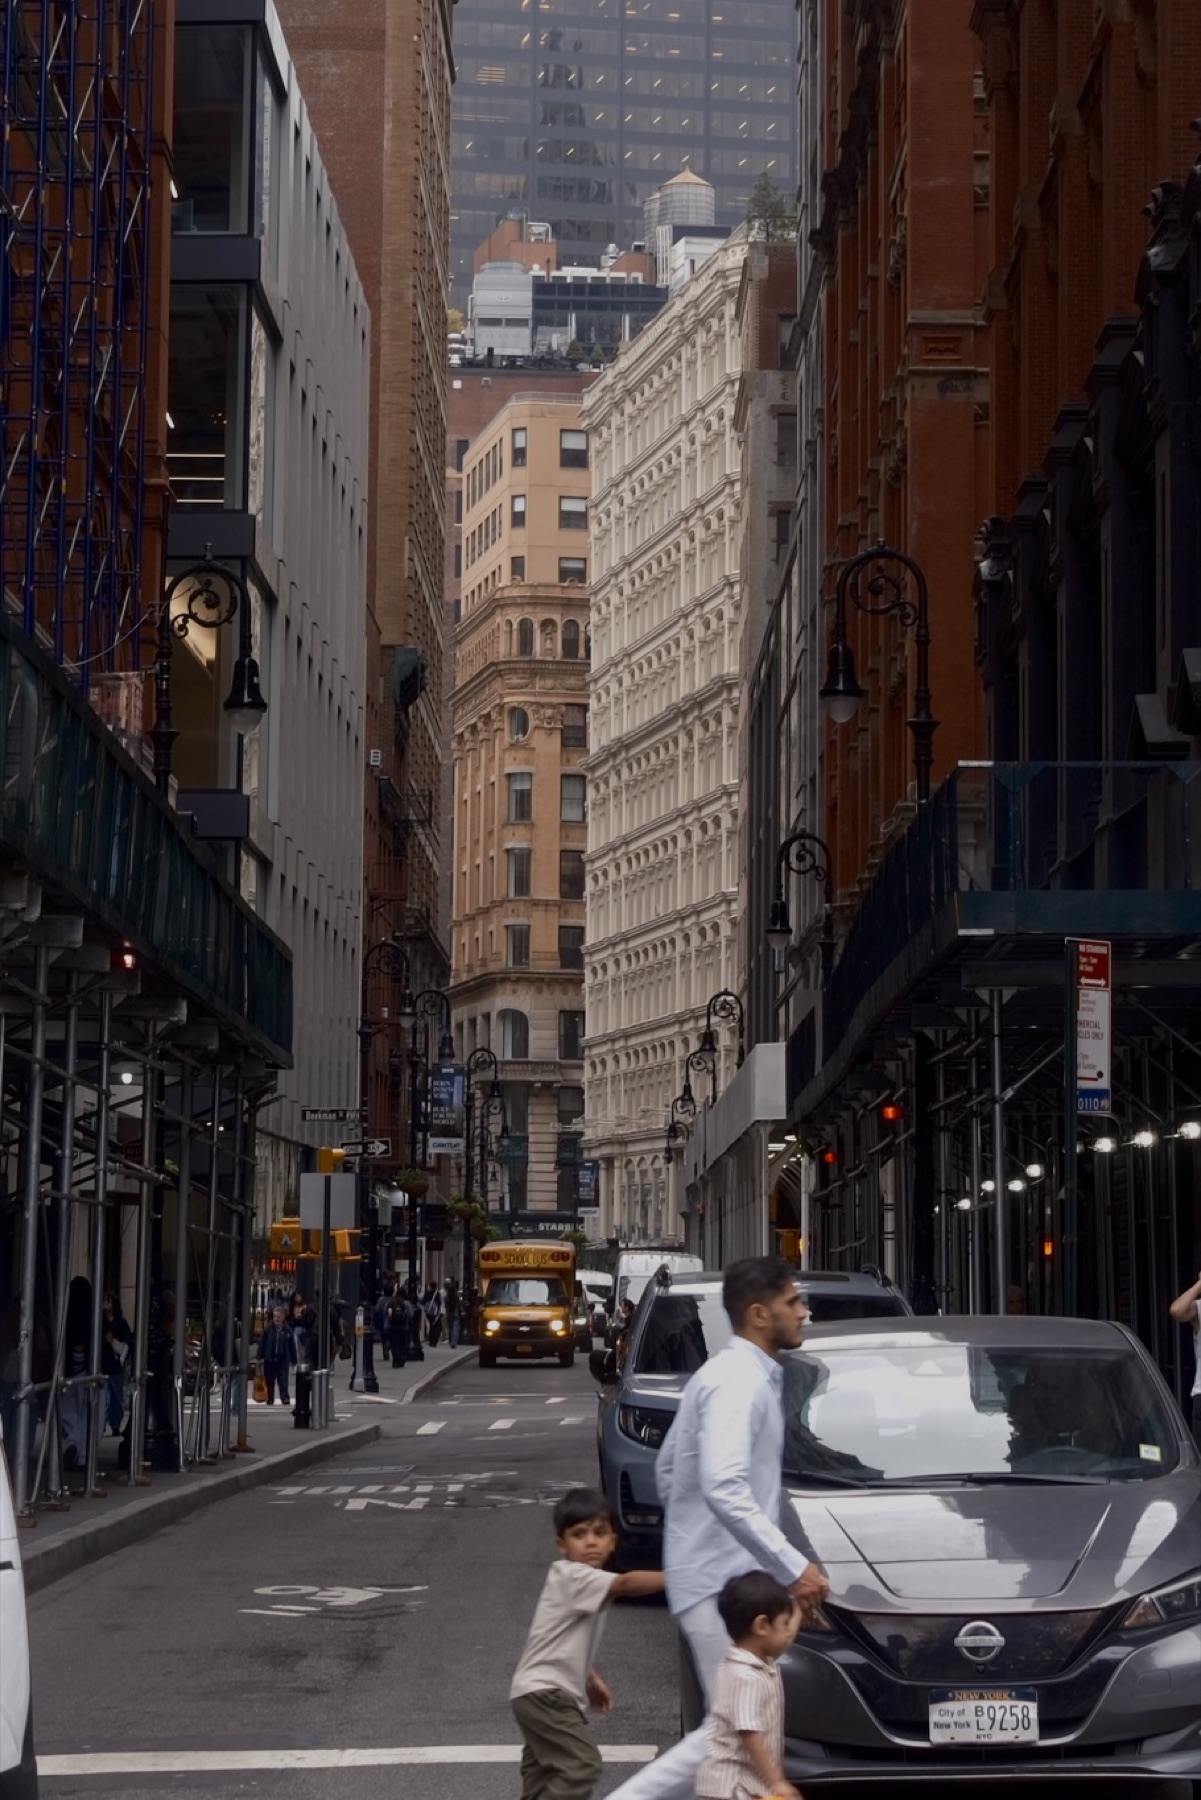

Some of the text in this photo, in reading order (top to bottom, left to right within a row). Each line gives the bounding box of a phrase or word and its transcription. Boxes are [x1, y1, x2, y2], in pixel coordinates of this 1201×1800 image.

[1086, 945, 1107, 954] STANDING
[1091, 1031, 1104, 1040] ONLY
[1078, 1097, 1099, 1110] 0110
[305, 1110, 337, 1120] Beekman
[504, 1253, 547, 1264] SCHOOL BUS
[954, 1691, 1010, 1701] NEW YORK
[937, 1708, 966, 1719] City of
[933, 1720, 971, 1730] New York
